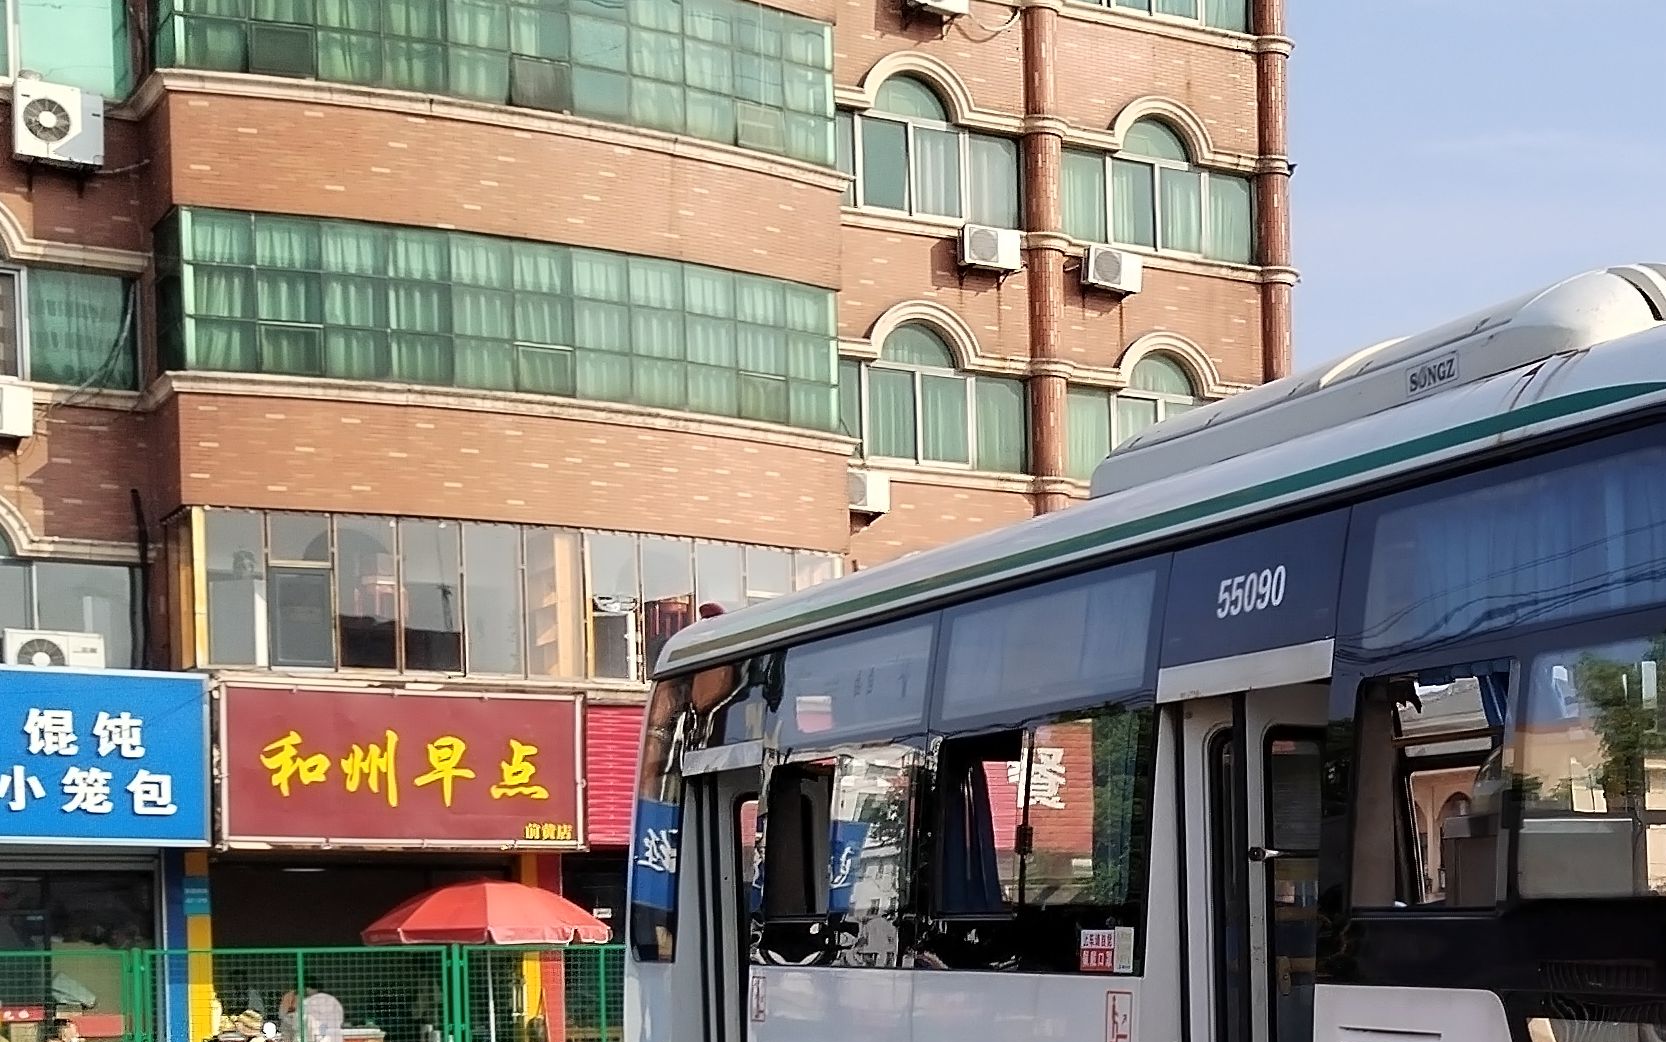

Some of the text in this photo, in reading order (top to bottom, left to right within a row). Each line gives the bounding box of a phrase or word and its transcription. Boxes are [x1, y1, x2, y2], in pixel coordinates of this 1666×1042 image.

[1409, 358, 1456, 392] SONGZ
[1216, 565, 1287, 619] 55090
[23, 707, 146, 758] 馄饨
[0, 764, 178, 816] 小笼包
[260, 729, 550, 808] 和州早点
